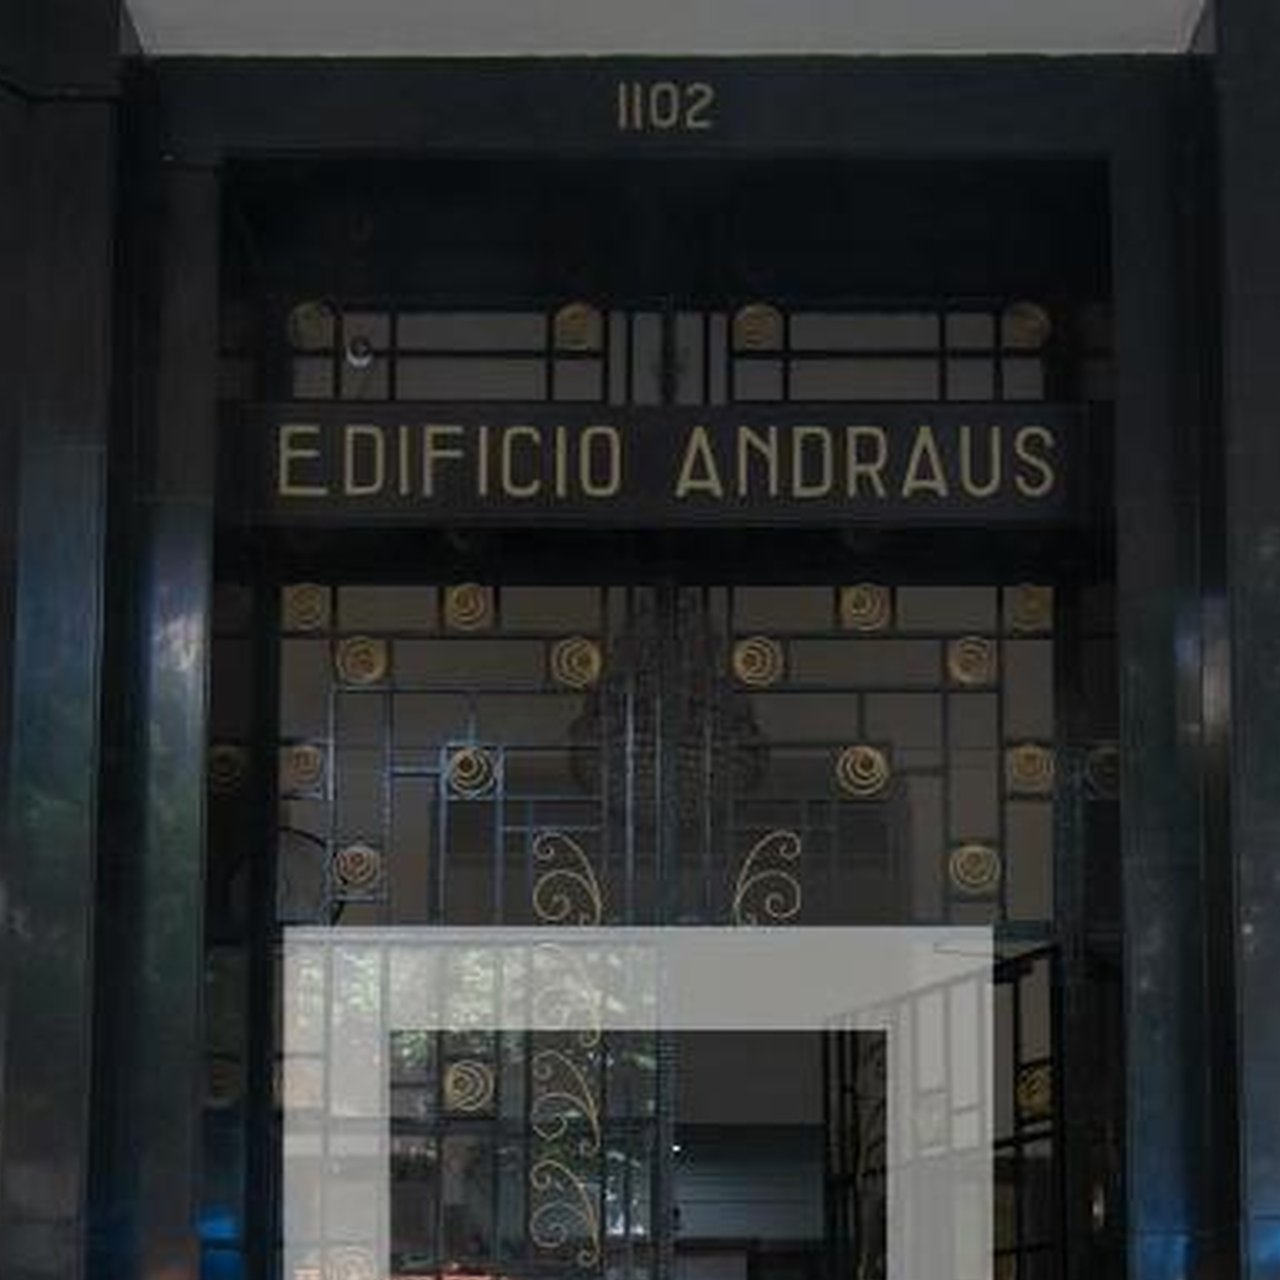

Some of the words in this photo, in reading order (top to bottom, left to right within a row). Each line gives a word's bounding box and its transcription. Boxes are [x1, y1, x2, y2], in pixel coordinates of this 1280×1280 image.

[618, 81, 715, 129] 1102
[278, 423, 621, 497] EDIFICIO
[675, 424, 1057, 498] ANDRAUS
